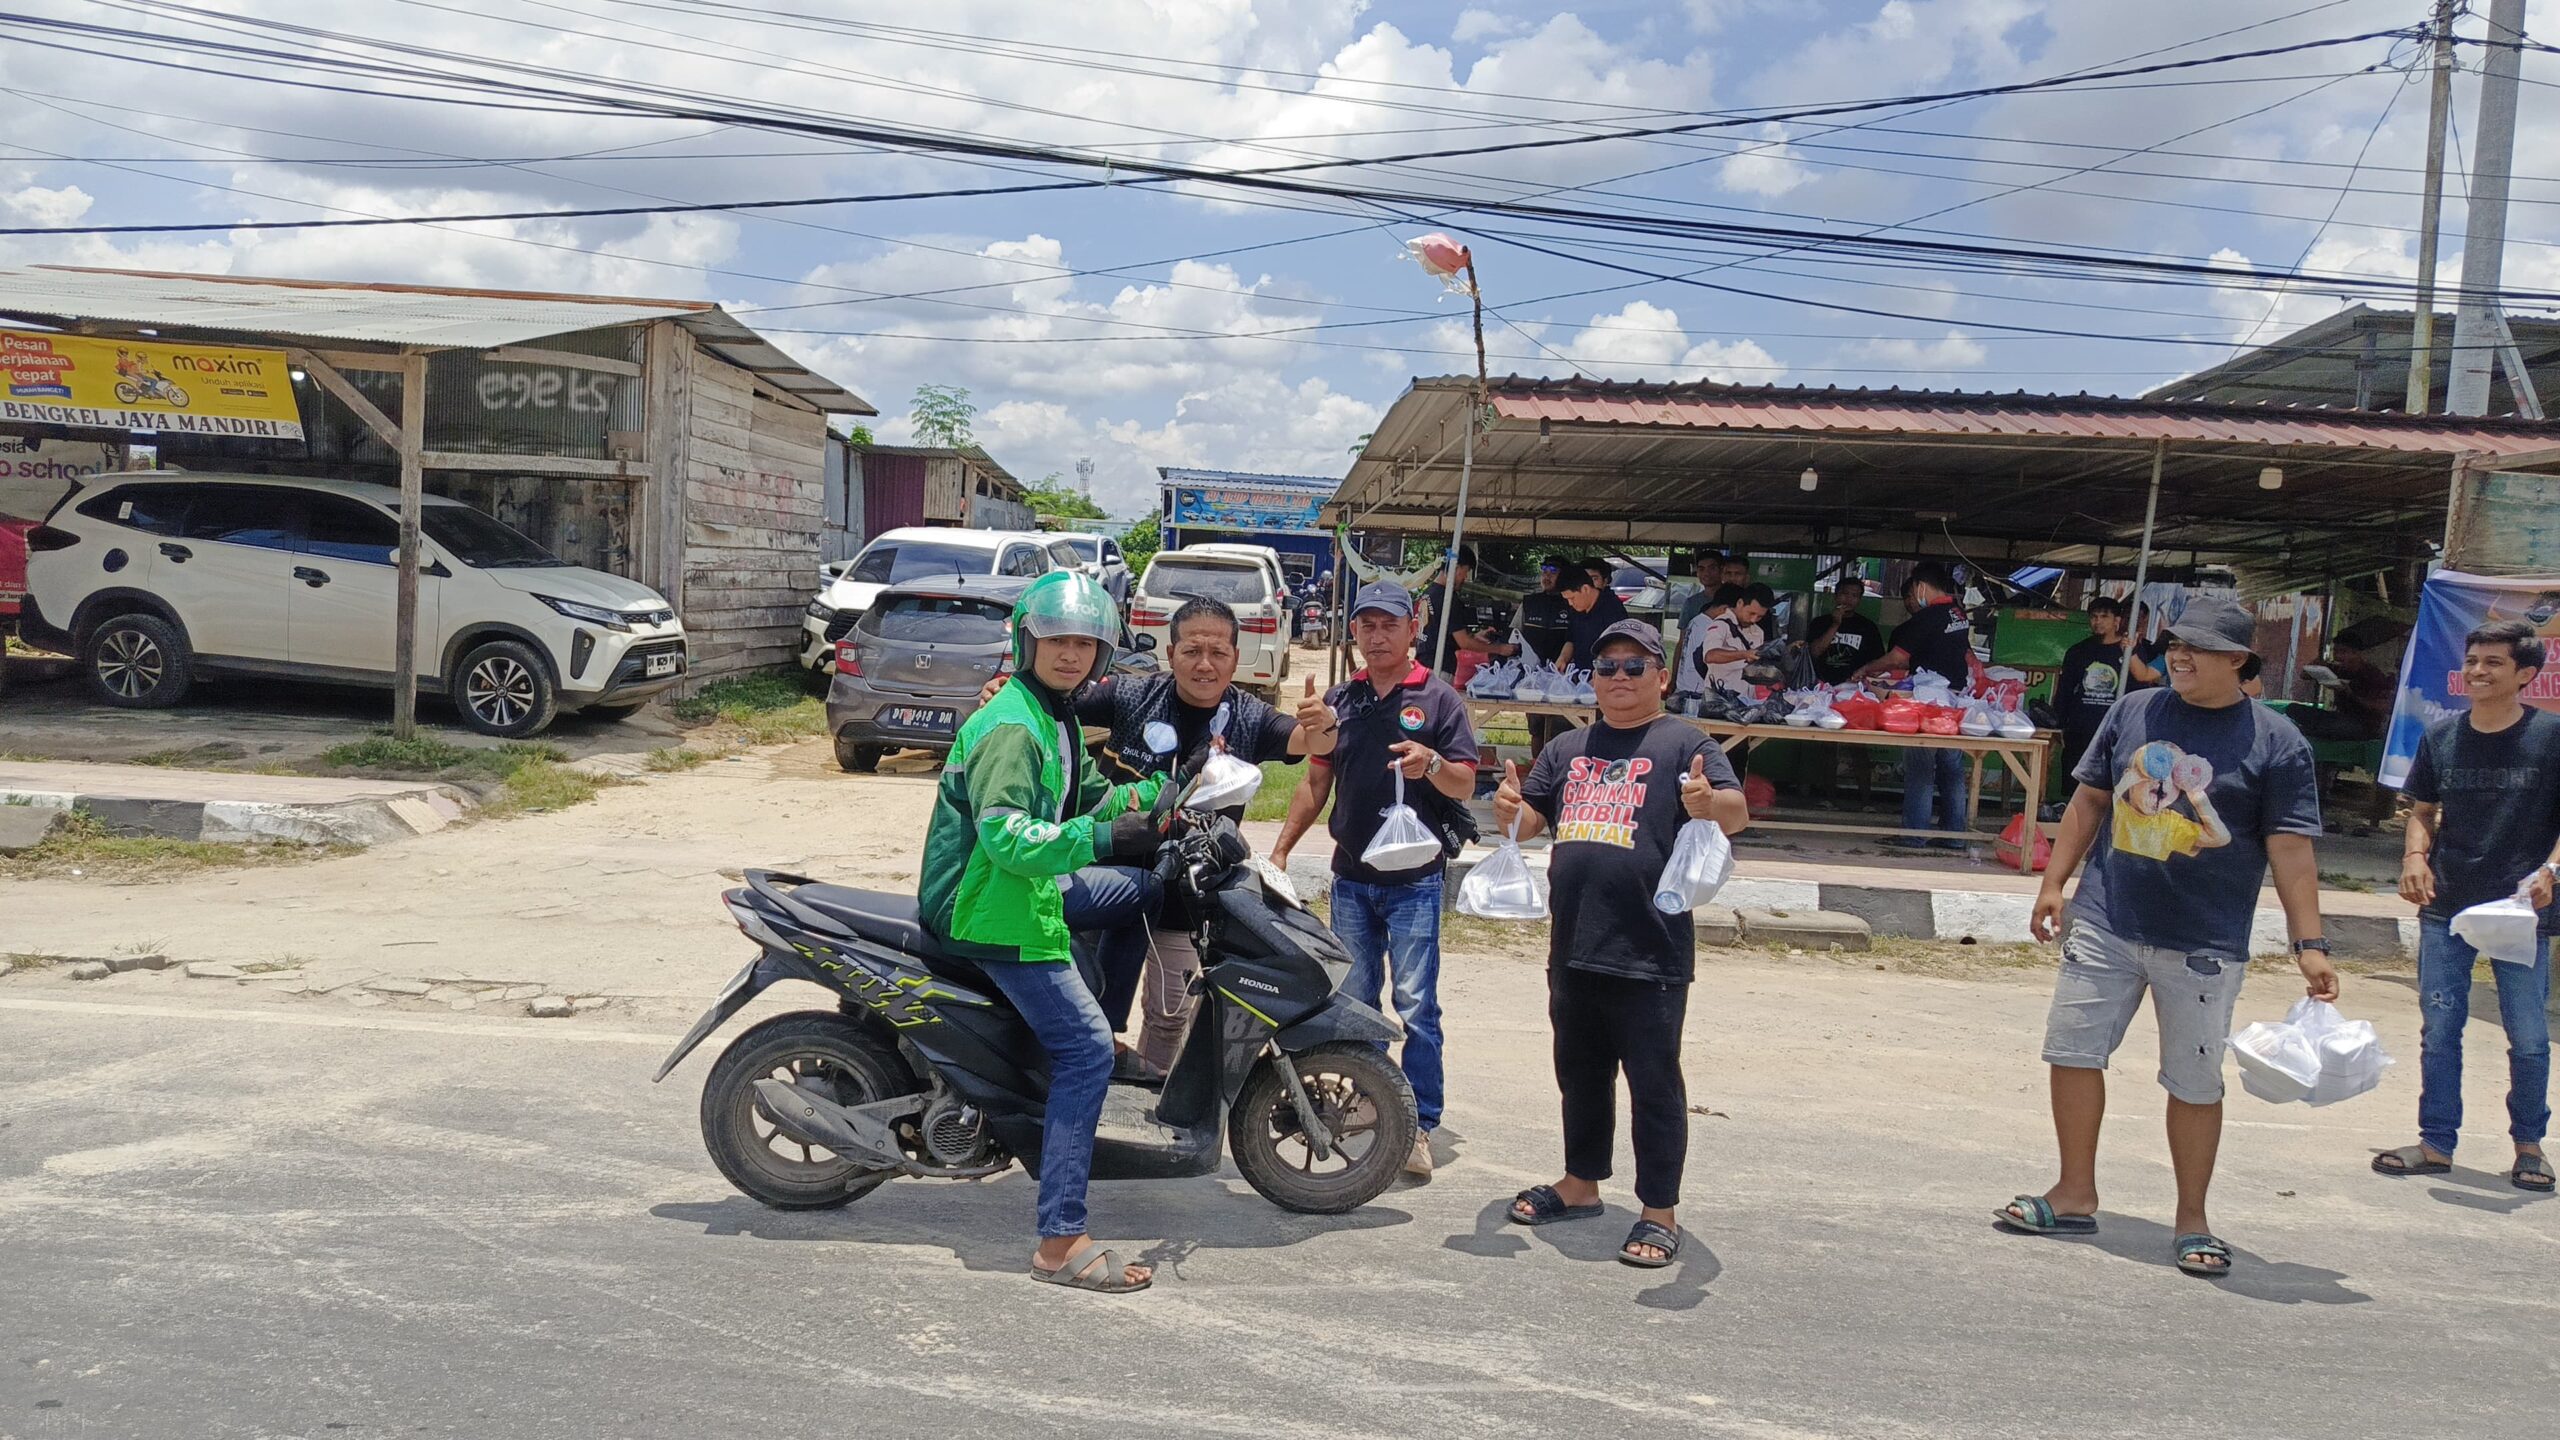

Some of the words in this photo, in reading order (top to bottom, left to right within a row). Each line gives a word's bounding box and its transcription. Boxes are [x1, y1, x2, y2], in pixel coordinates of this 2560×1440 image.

[4, 336, 48, 351] Pesan
[0, 352, 69, 367] erjalanan
[172, 354, 261, 376] maxim
[14, 370, 56, 383] cepat
[4, 402, 108, 425] BENGKEL
[115, 411, 171, 430] JAYA
[178, 414, 279, 436] MANDIRI
[1122, 746, 1140, 758] ZHUL
[1567, 756, 1652, 785] STOP
[1560, 804, 1639, 830] MOBIL
[1554, 822, 1635, 849] RENTAL
[1238, 977, 1280, 994] HONDA
